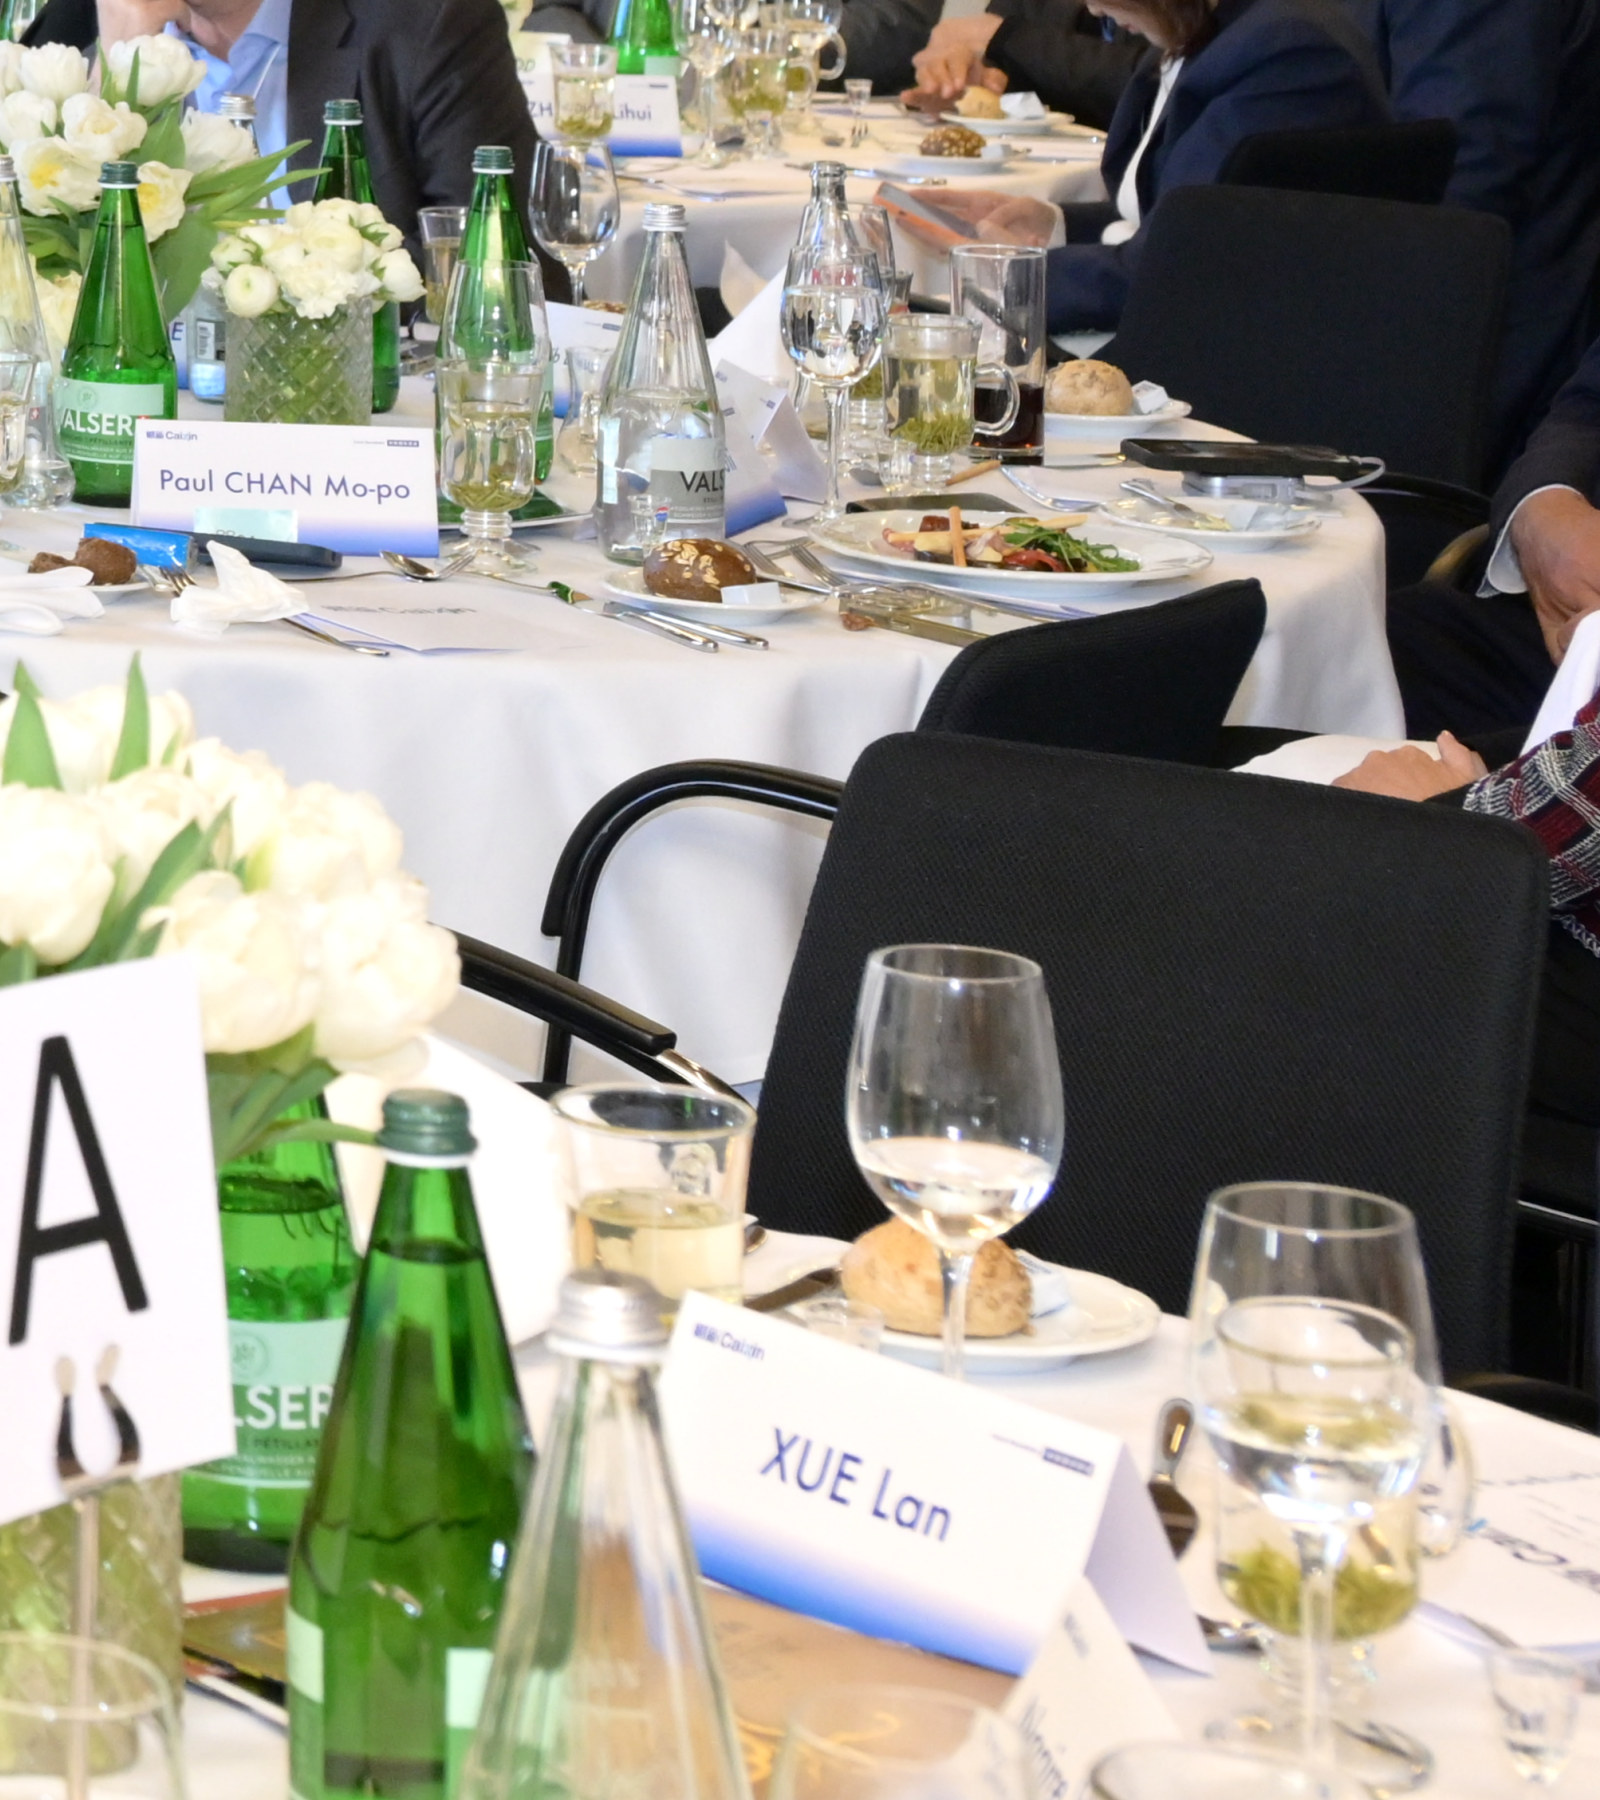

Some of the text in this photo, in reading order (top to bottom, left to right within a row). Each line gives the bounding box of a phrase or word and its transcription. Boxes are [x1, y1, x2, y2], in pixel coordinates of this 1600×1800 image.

[160, 469, 411, 505] Paul CHAN Mo-po
[8, 1034, 151, 1348] A
[234, 1384, 333, 1430] SER
[759, 1427, 952, 1542] XUE Lan
